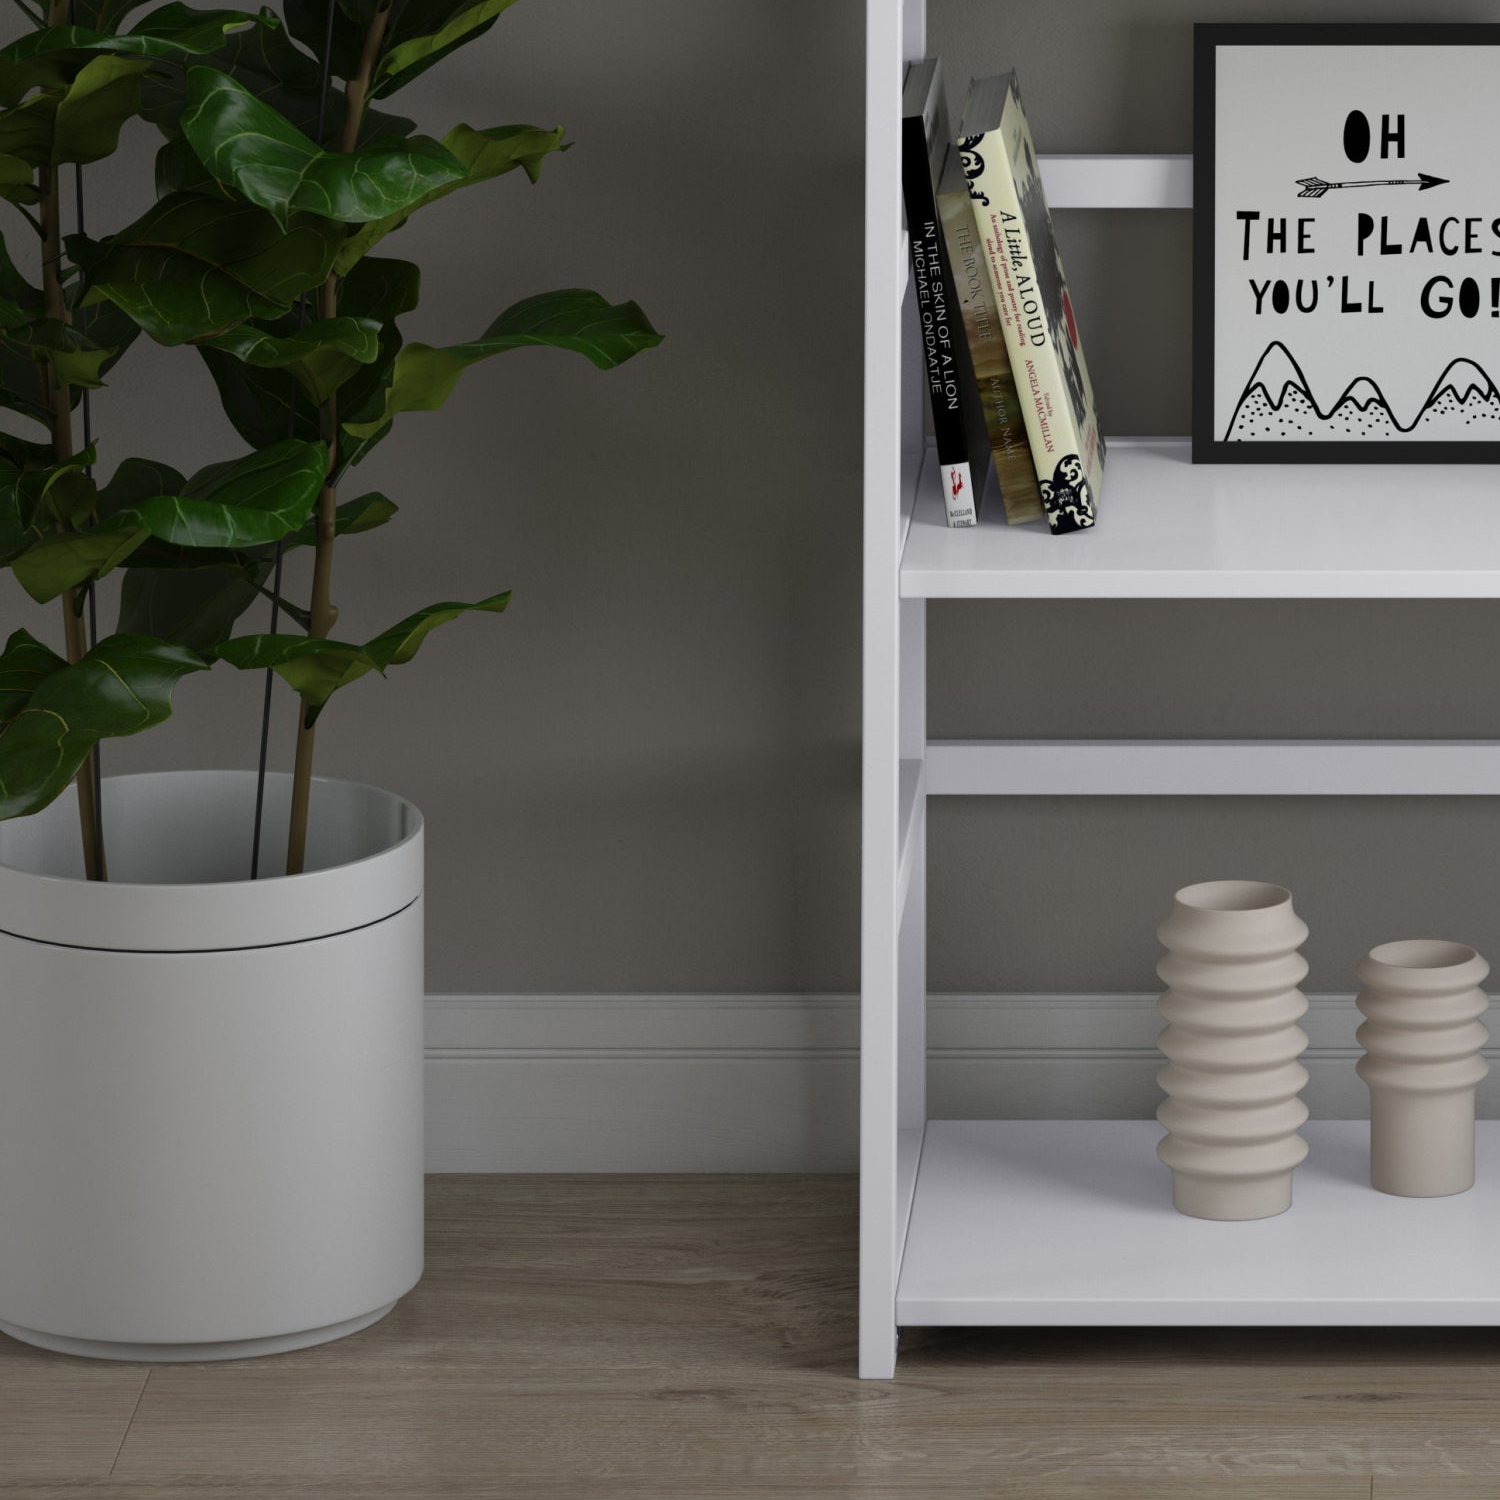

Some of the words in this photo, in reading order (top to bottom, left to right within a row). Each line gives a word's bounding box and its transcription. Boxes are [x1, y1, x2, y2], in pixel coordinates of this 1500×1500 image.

[1343, 109, 1406, 164] OH
[924, 221, 936, 238] IN
[1000, 210, 1017, 224] A
[1236, 211, 1316, 260] THE
[927, 243, 941, 277] THE
[956, 224, 974, 256] THE
[1004, 227, 1028, 272] Little,
[963, 258, 983, 301] BOOK
[1248, 274, 1384, 315] YOU'LL
[1420, 275, 1500, 319] GO!
[912, 240, 930, 309] MICHAEL
[922, 312, 943, 394] ONDAATJE
[932, 282, 947, 321] SKIN
[973, 301, 992, 341] TITLE
[1016, 274, 1046, 347] ALOUD
[937, 327, 951, 349] OF
[941, 354, 953, 366] A
[944, 370, 958, 410] LION
[1024, 359, 1041, 396] ANGELA
[1034, 396, 1054, 453] MACMILLAN
[990, 378, 1008, 423] AUTHOR
[1001, 427, 1017, 461] NAME
